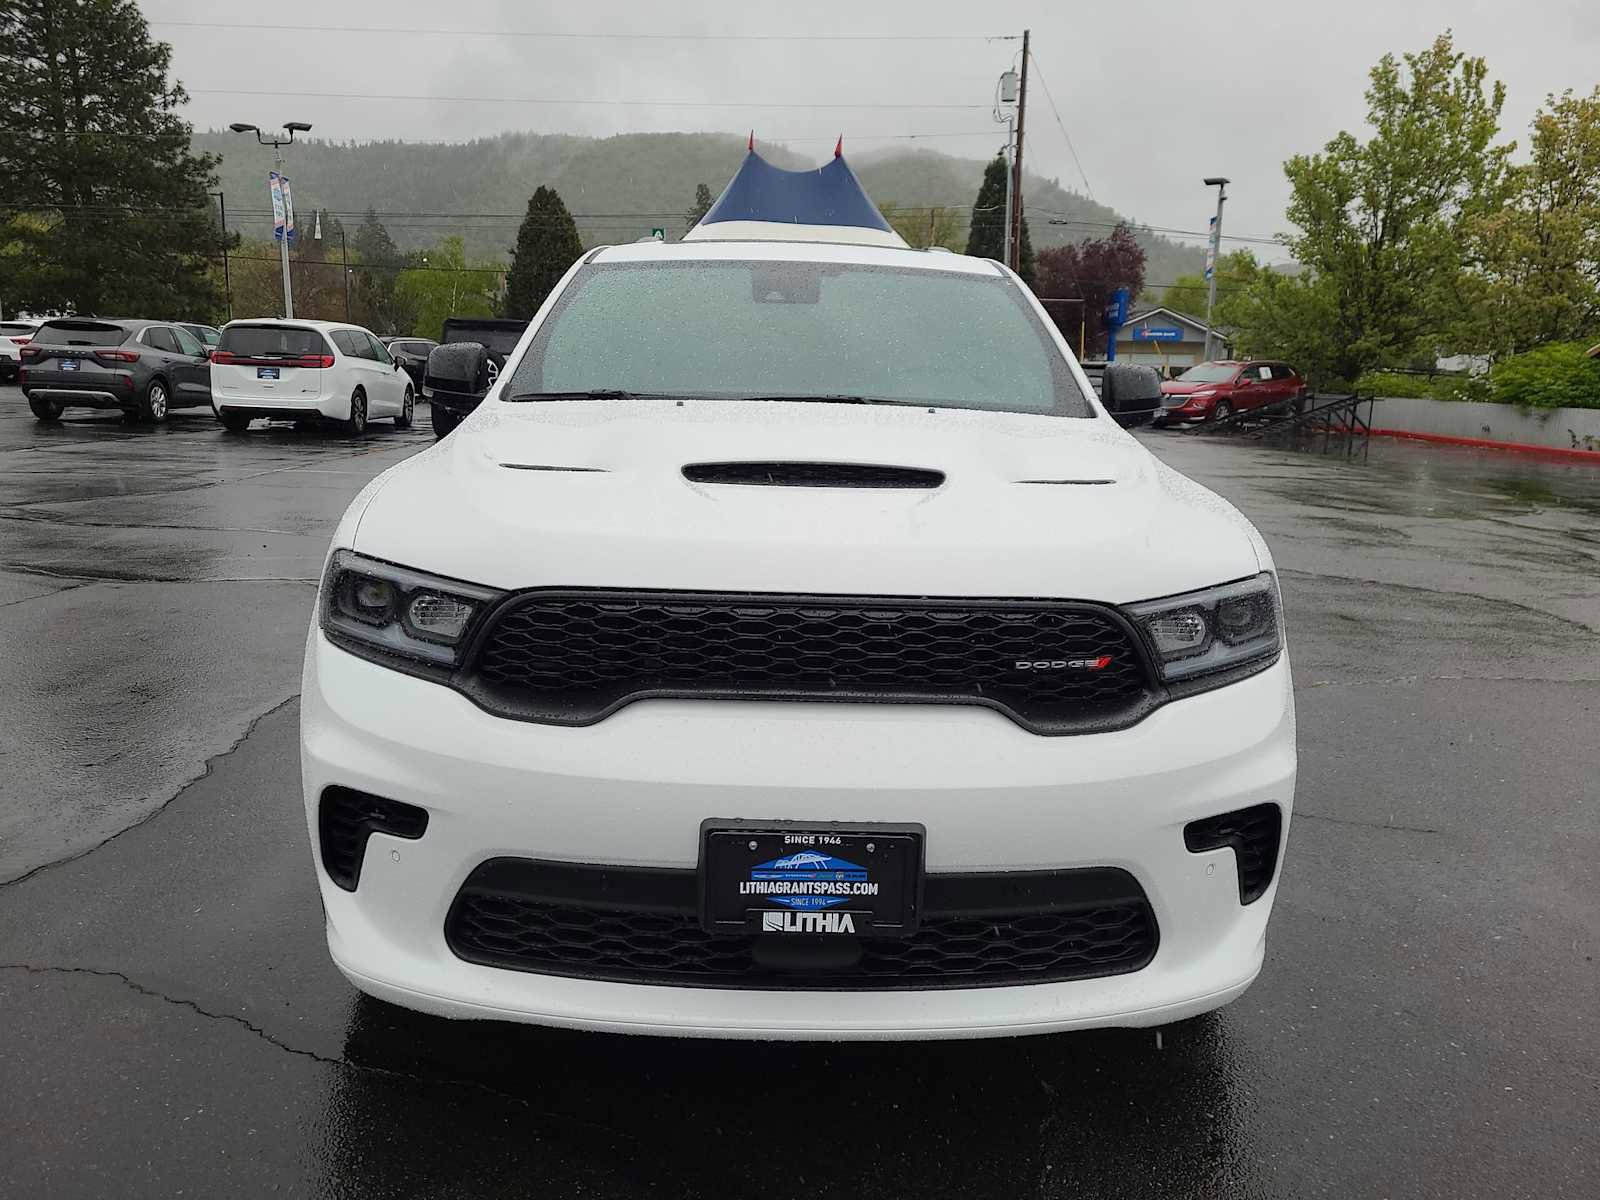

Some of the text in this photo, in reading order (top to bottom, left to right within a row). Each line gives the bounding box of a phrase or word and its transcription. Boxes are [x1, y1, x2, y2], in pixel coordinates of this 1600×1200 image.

[1015, 660, 1100, 670] DODGE
[784, 835, 816, 845] SINCE
[739, 881, 879, 896] LITHIAGRANTSPASS.COM
[790, 897, 809, 906] SINCE
[783, 912, 855, 934] LITHIA
